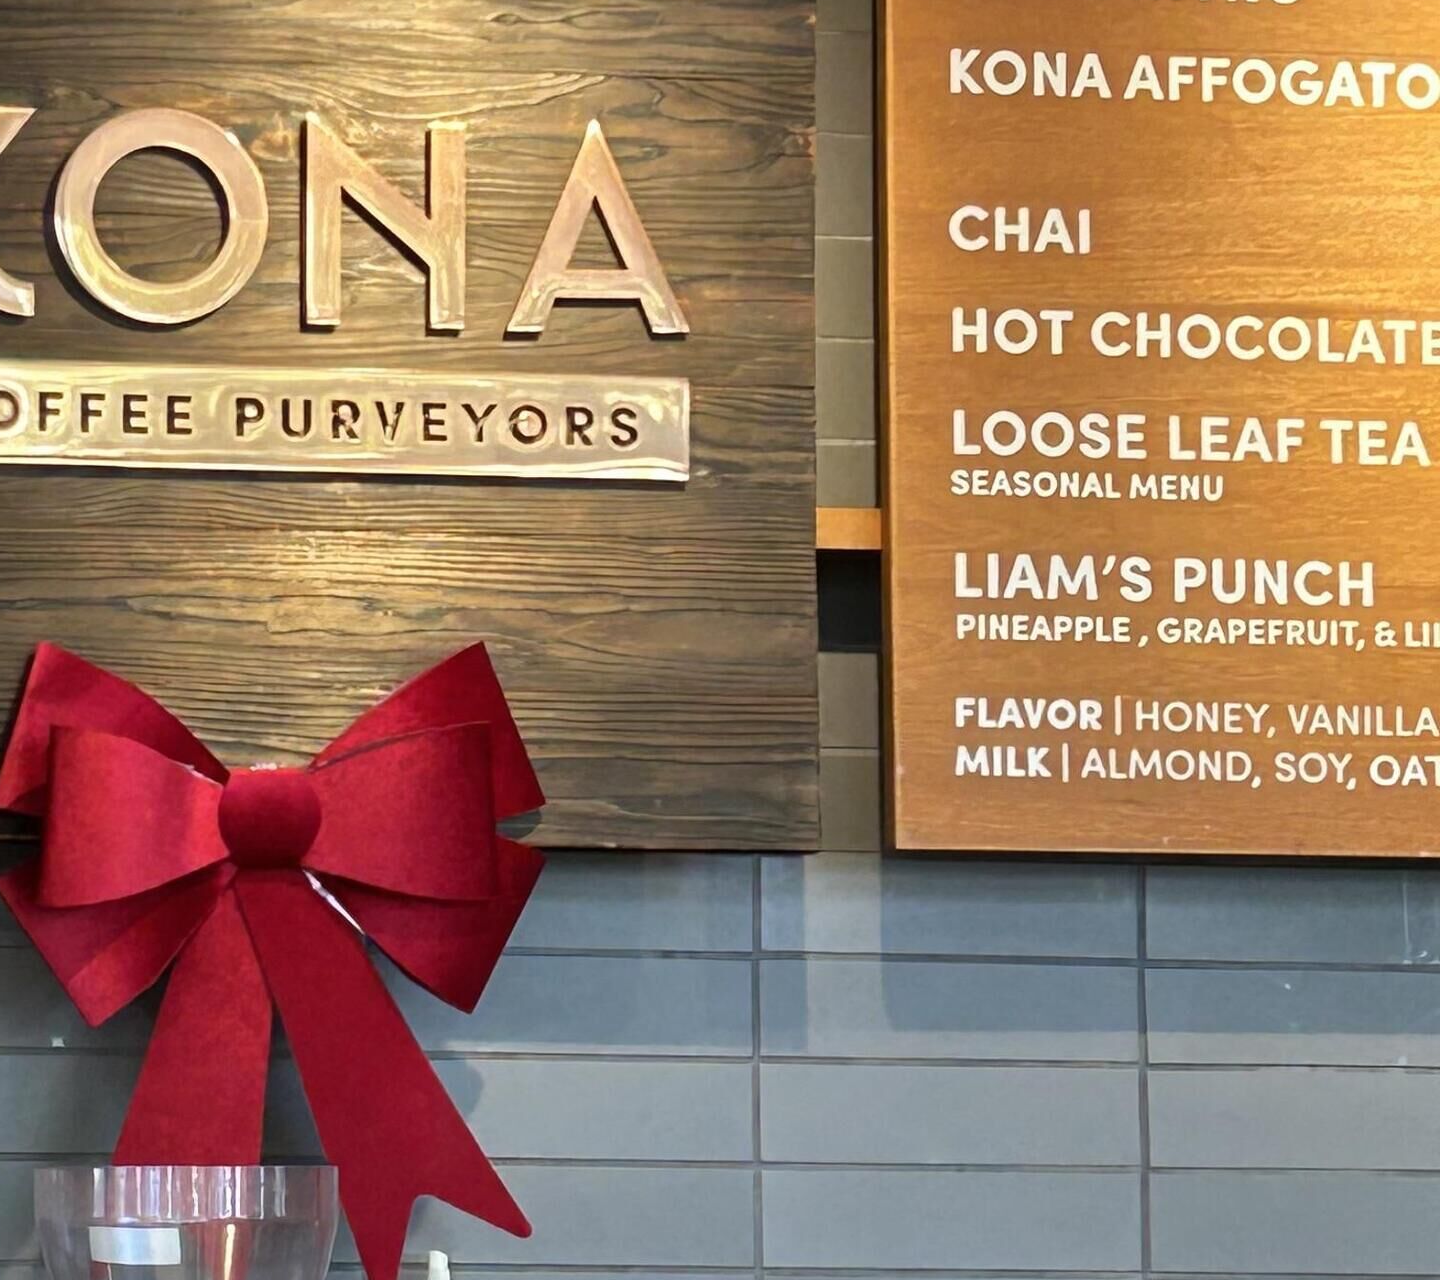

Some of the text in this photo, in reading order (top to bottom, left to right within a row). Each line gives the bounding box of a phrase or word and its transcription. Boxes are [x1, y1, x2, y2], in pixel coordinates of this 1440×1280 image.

[950, 47, 1440, 110] KONA AFFOGATO
[948, 204, 1091, 254] CHAI
[952, 306, 1440, 365] HOT CHOCOLATE
[235, 395, 641, 448] PURVEYORS
[953, 409, 1431, 467] LOOSE LEAF TEA
[950, 469, 1224, 502] SEASONAL MENU
[955, 552, 1374, 607] LIAM'S PUNCH
[1156, 617, 1365, 651] GRAPEFRUIT,
[1374, 620, 1398, 647] &
[1404, 621, 1440, 648] LI
[955, 697, 1103, 731] FLAVOR
[1135, 700, 1276, 738] HONEY,
[1287, 704, 1440, 737] VANILLA
[955, 745, 1052, 778] MILK
[1081, 747, 1262, 789] ALMOND,
[1274, 751, 1357, 791] SOY,
[1369, 754, 1440, 787] OAT
